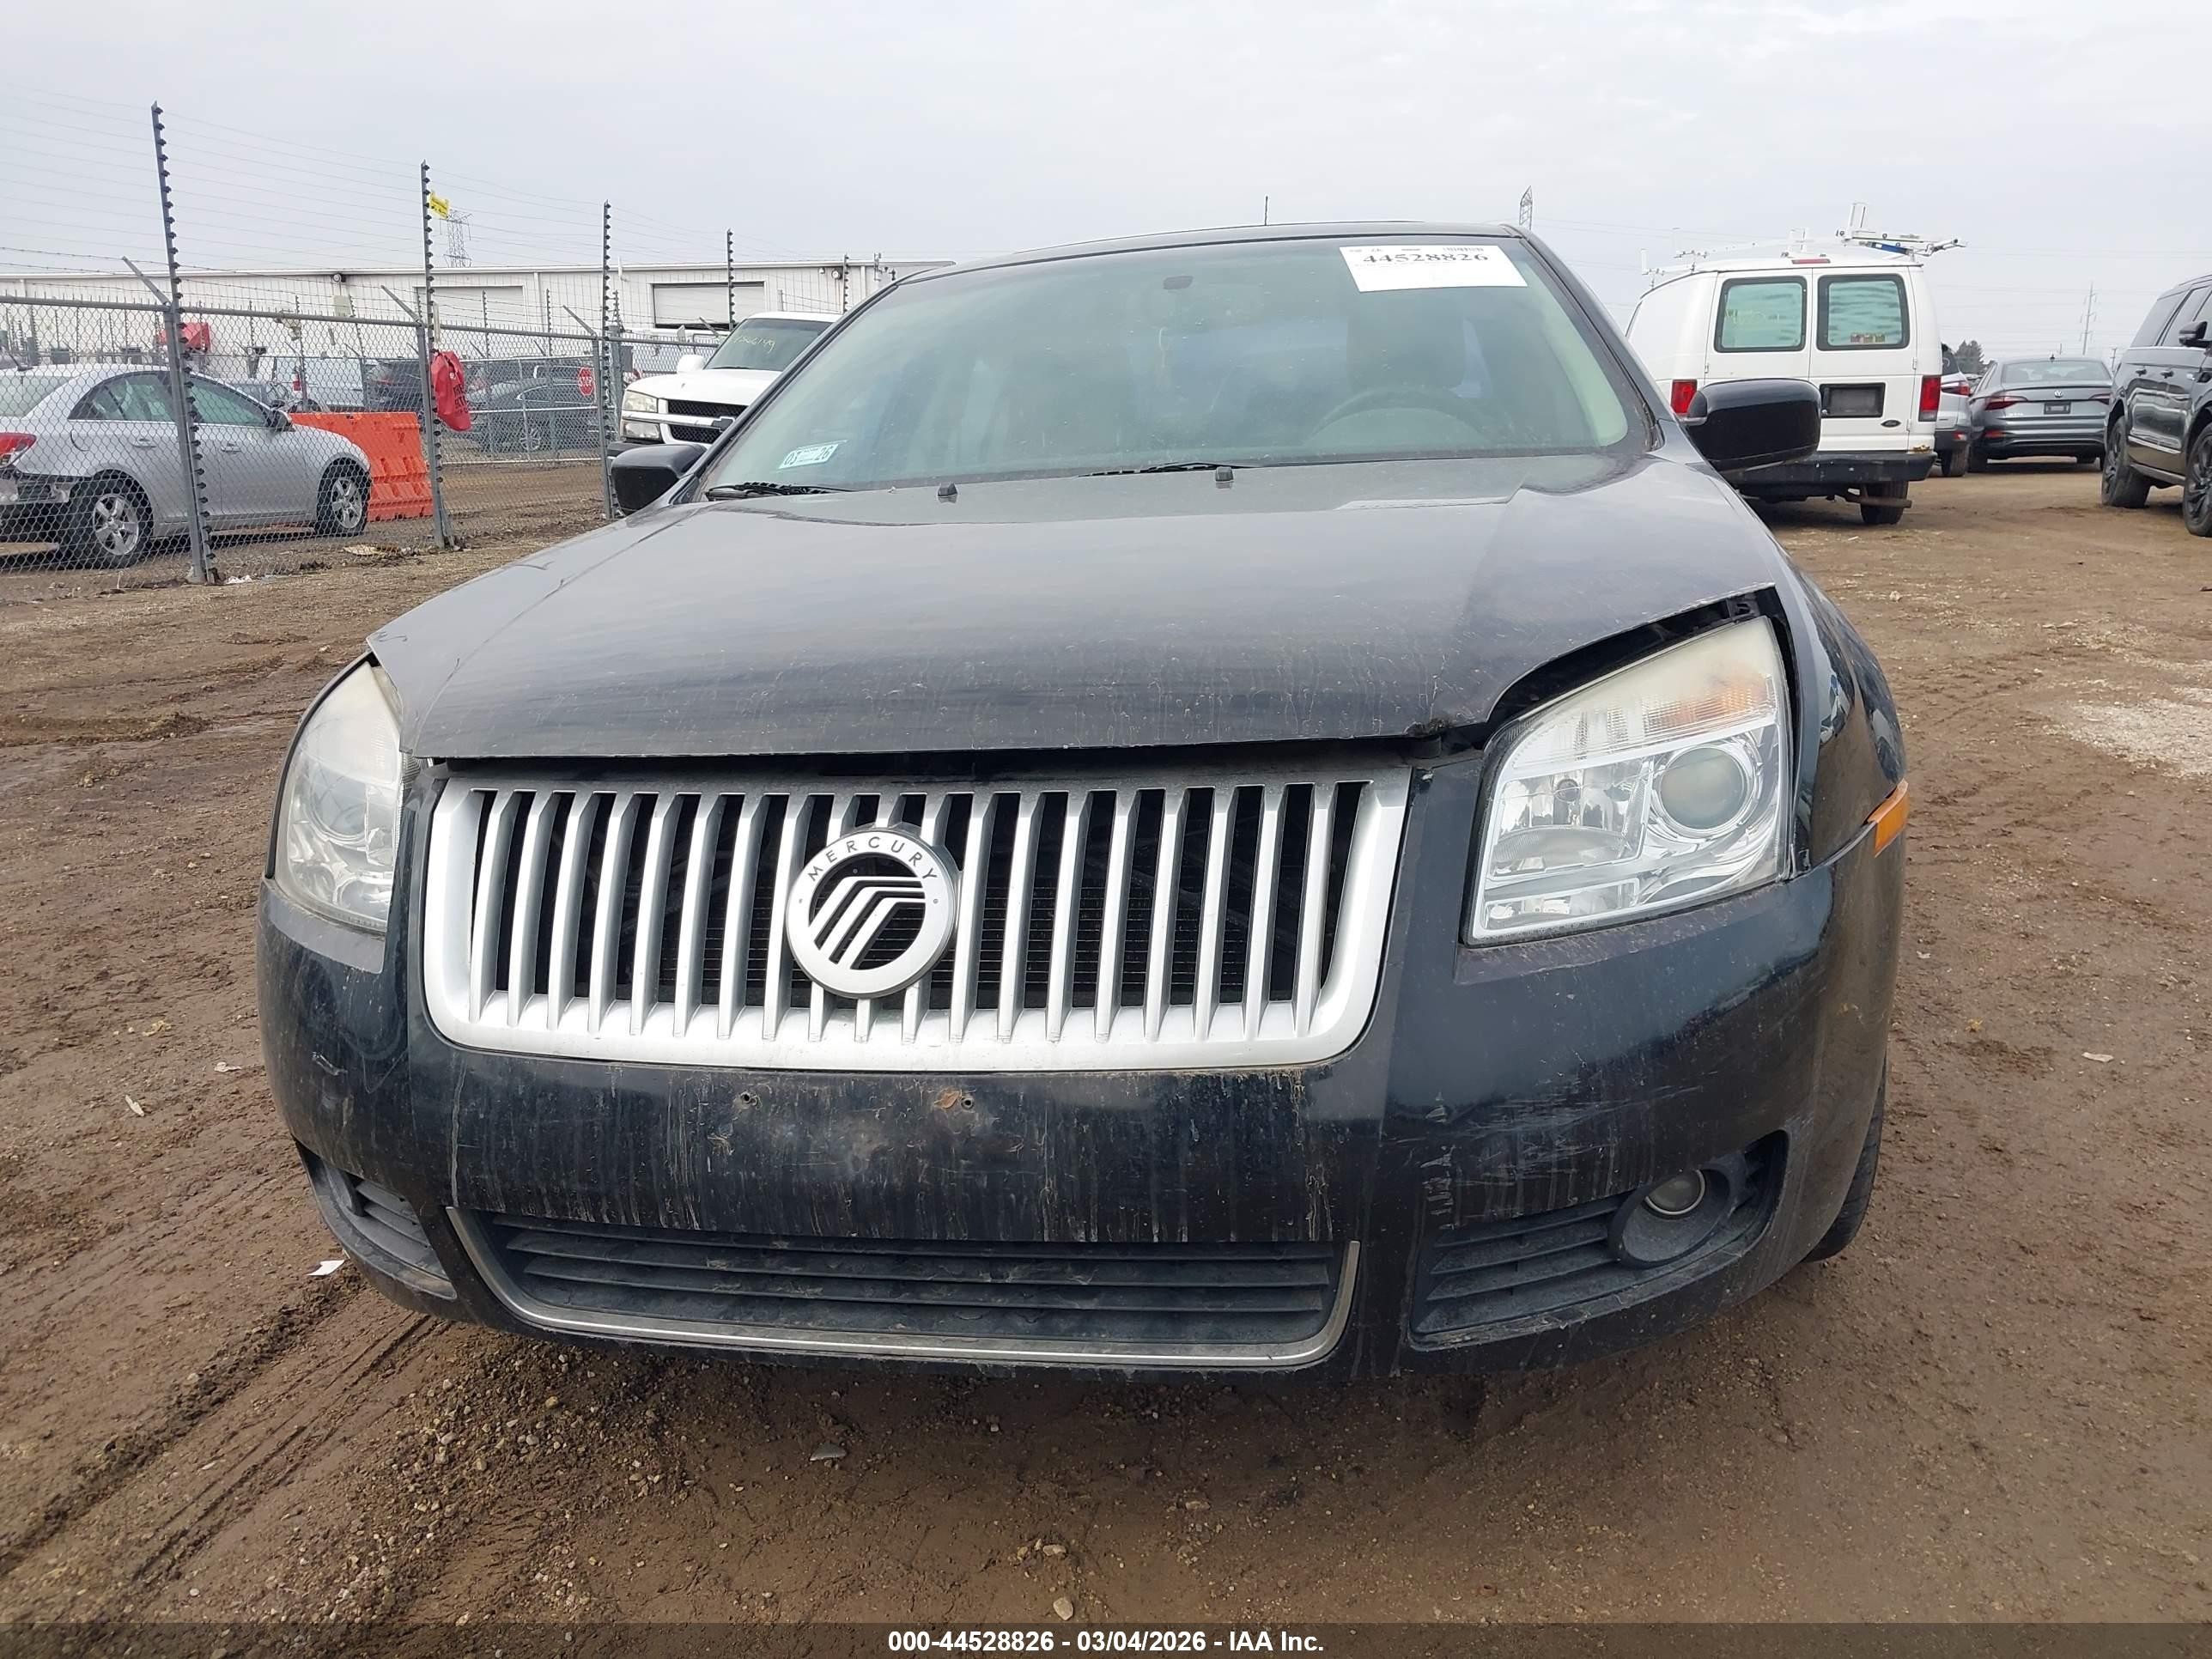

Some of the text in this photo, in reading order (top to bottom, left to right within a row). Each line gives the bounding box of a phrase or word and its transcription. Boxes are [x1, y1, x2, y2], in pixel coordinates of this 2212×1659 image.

[1363, 253, 1489, 263] 44528826
[578, 376, 593, 386] STOP
[807, 836, 938, 882] MERCURY
